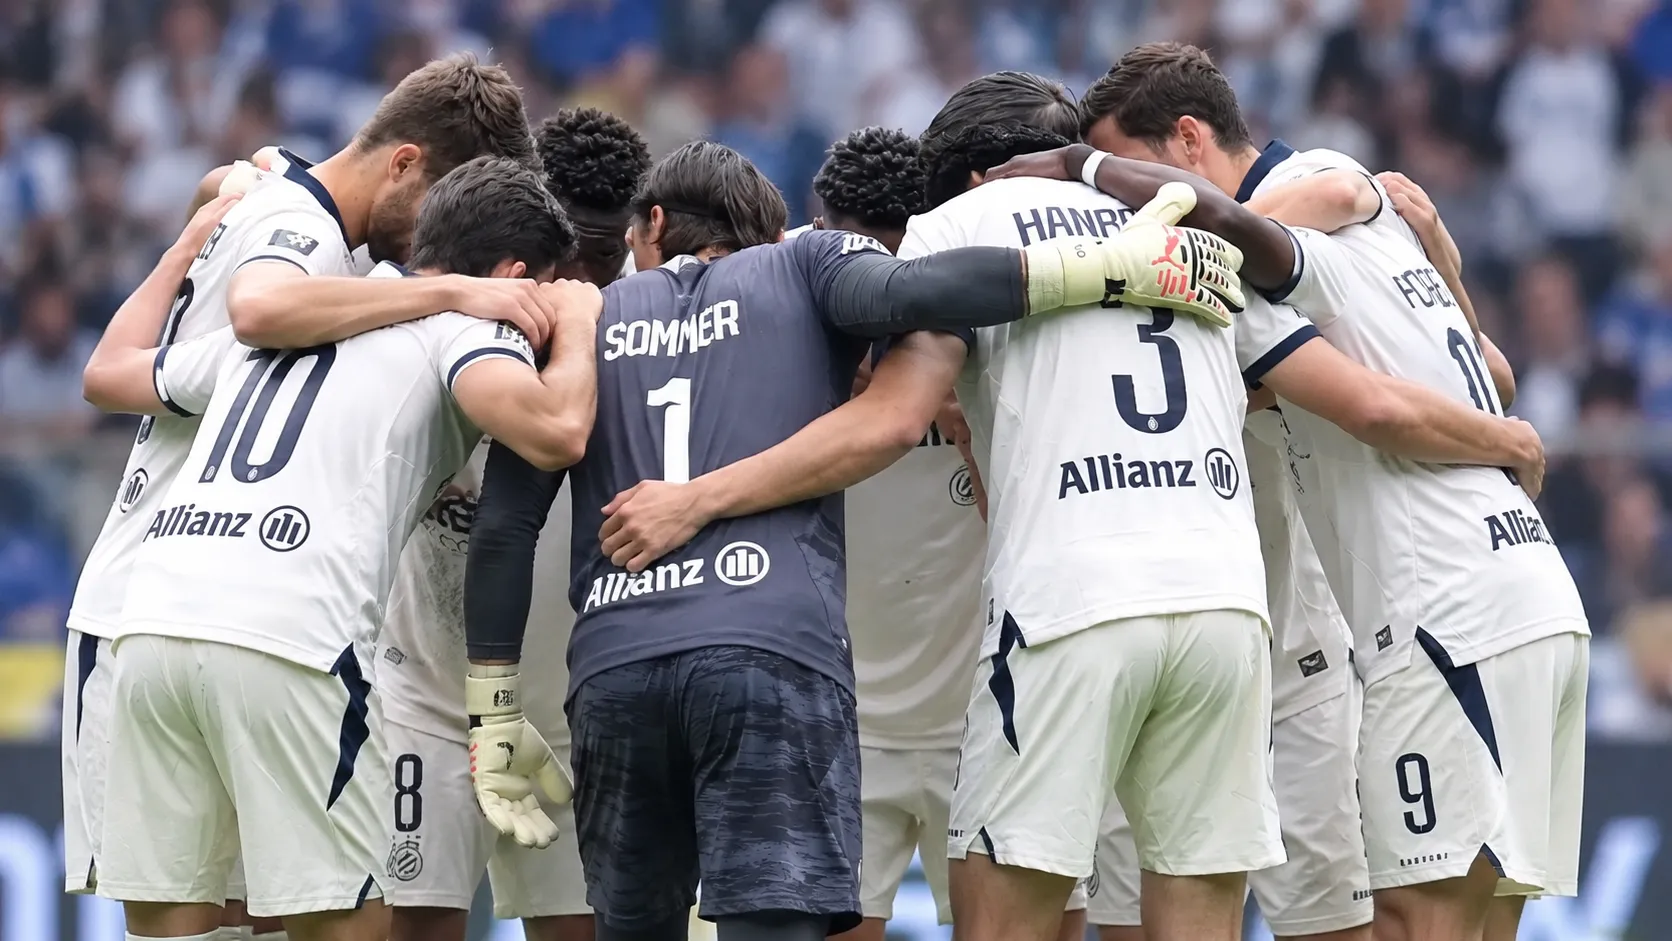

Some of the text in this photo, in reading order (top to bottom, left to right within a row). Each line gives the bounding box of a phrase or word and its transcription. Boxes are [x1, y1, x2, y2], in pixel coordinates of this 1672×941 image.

[604, 299, 740, 361] SOMMER
[1111, 306, 1188, 433] 3
[198, 342, 337, 483] 10
[646, 377, 691, 484] 1
[1058, 453, 1197, 499] Allianz
[142, 503, 253, 542] Allianz
[583, 558, 704, 613] Allianz
[394, 753, 423, 832] 8
[1395, 753, 1437, 834] 9
